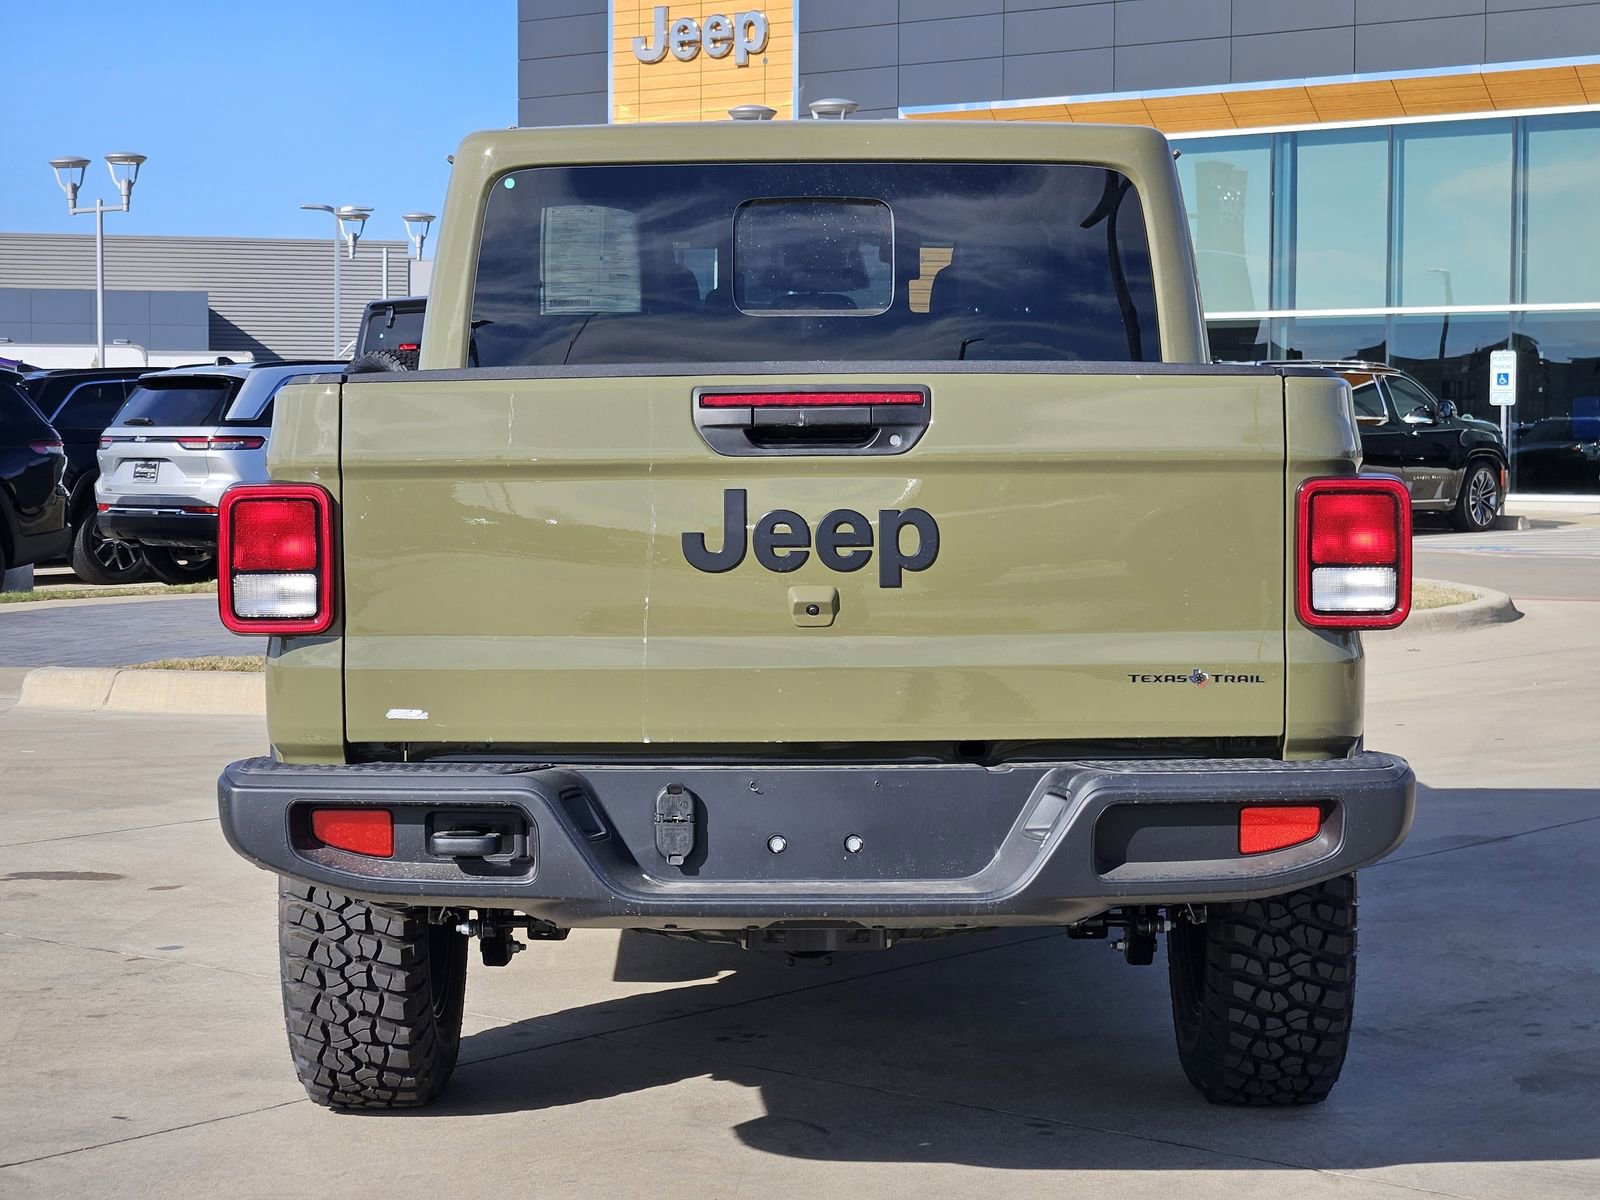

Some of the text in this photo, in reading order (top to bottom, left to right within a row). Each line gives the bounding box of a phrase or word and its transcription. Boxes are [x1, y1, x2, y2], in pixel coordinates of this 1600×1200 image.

[632, 6, 769, 67] Jeep
[682, 489, 940, 588] Jeep
[1128, 674, 1265, 683] TEXAS TRAIL
